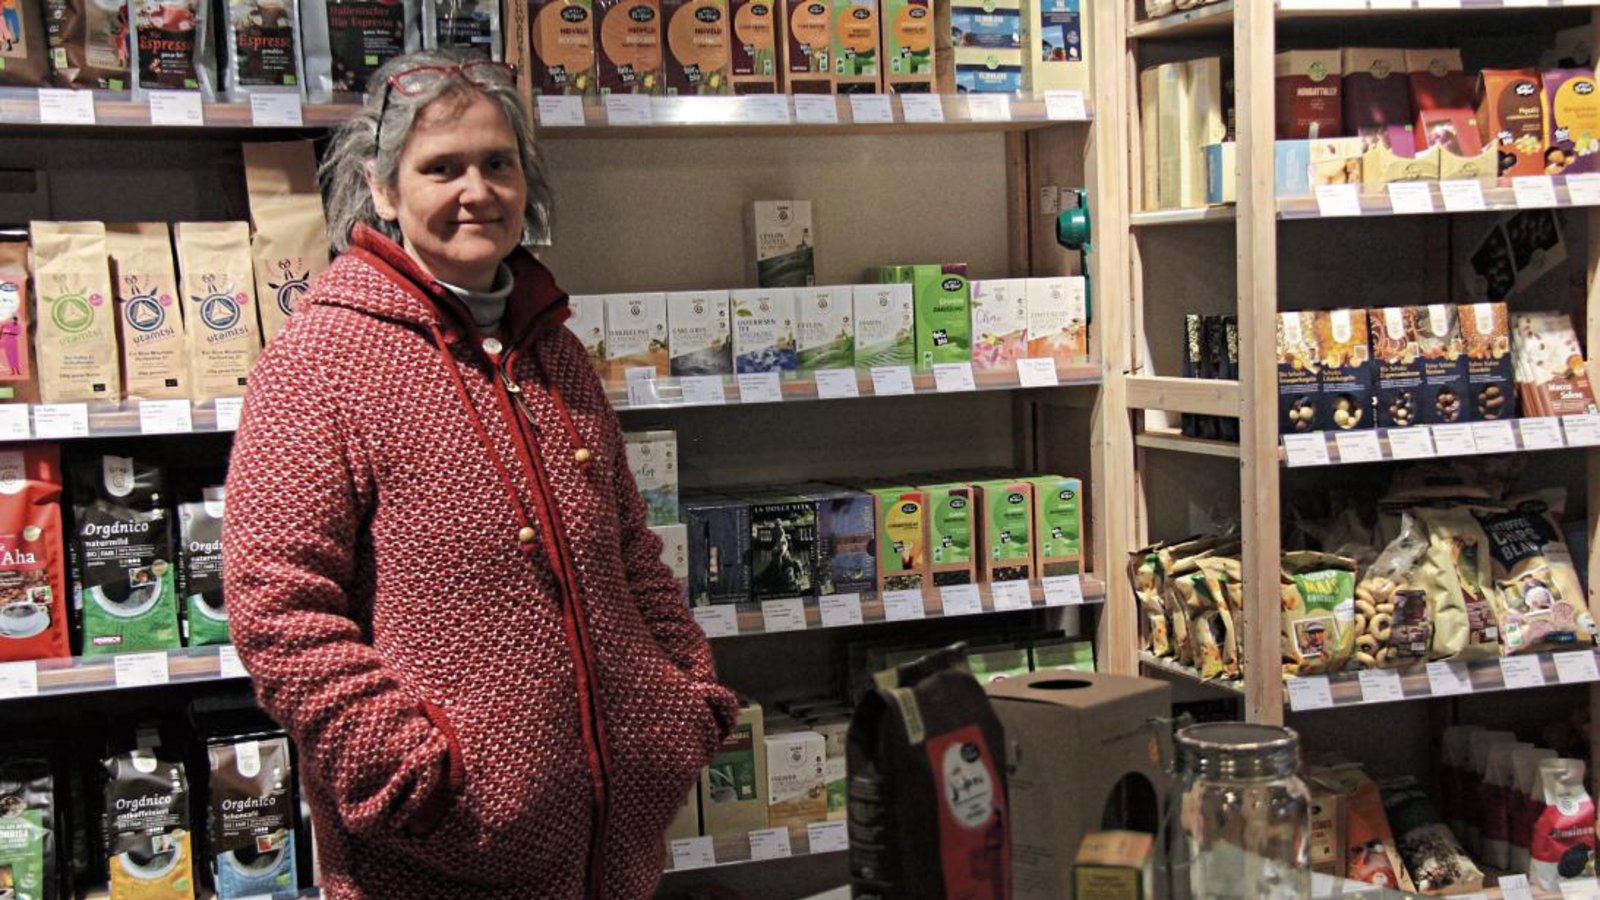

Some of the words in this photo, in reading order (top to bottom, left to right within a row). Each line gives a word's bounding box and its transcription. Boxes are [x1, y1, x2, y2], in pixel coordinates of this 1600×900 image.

[140, 37, 189, 54] Espress
[239, 33, 290, 51] Espress
[133, 326, 175, 344] utamtsi
[207, 323, 249, 343] utamtsi
[85, 537, 129, 547] naturmild
[3, 548, 36, 565] Aha
